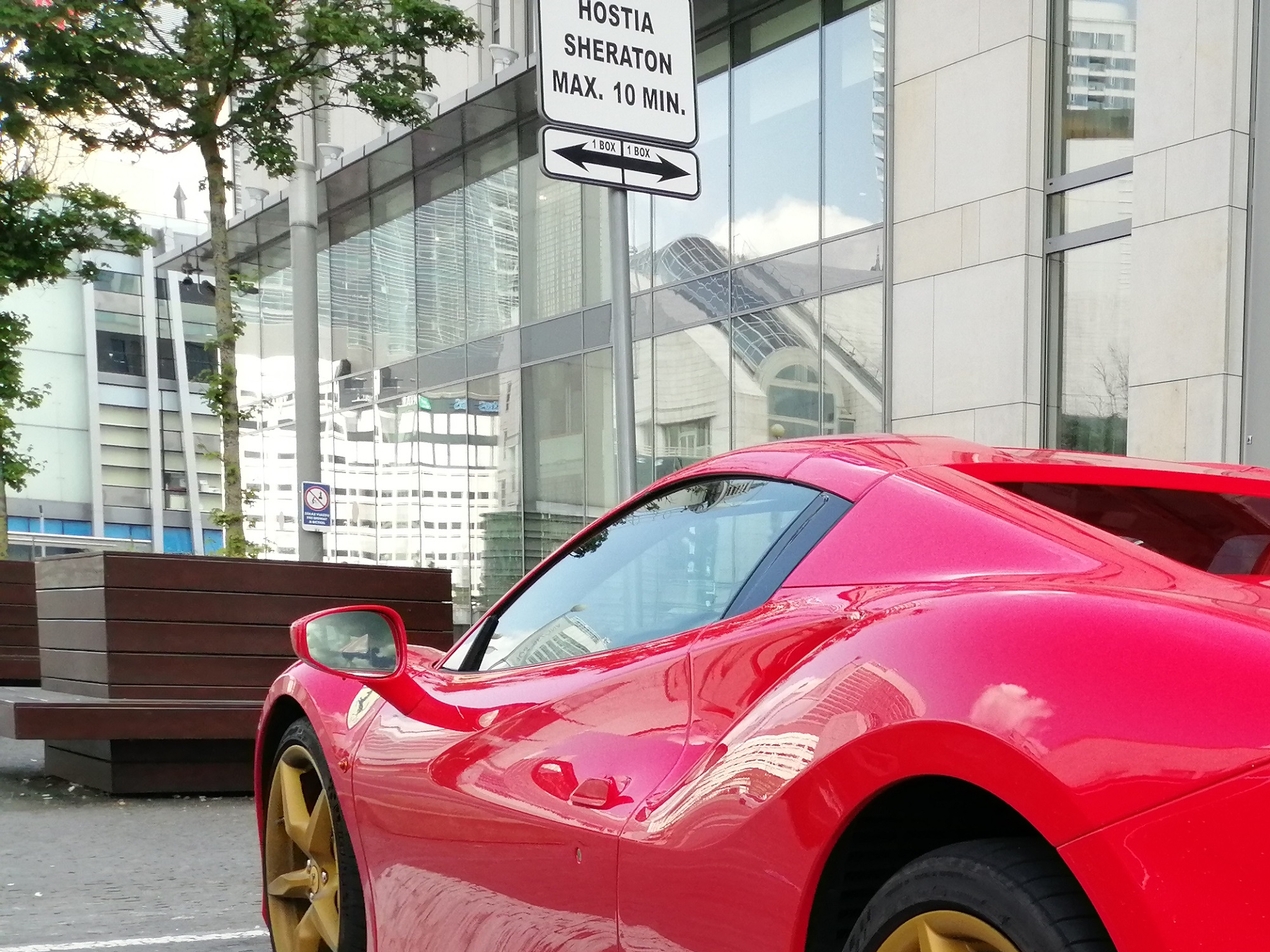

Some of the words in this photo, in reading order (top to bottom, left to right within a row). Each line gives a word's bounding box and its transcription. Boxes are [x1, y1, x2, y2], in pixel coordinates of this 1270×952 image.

[579, 0, 654, 34] HOSTIA
[564, 33, 672, 75] SHERATON
[552, 69, 603, 100] MAX.
[614, 81, 635, 106] 10
[643, 87, 685, 115] MIN.
[600, 141, 616, 152] BOX
[634, 147, 650, 158] BOX
